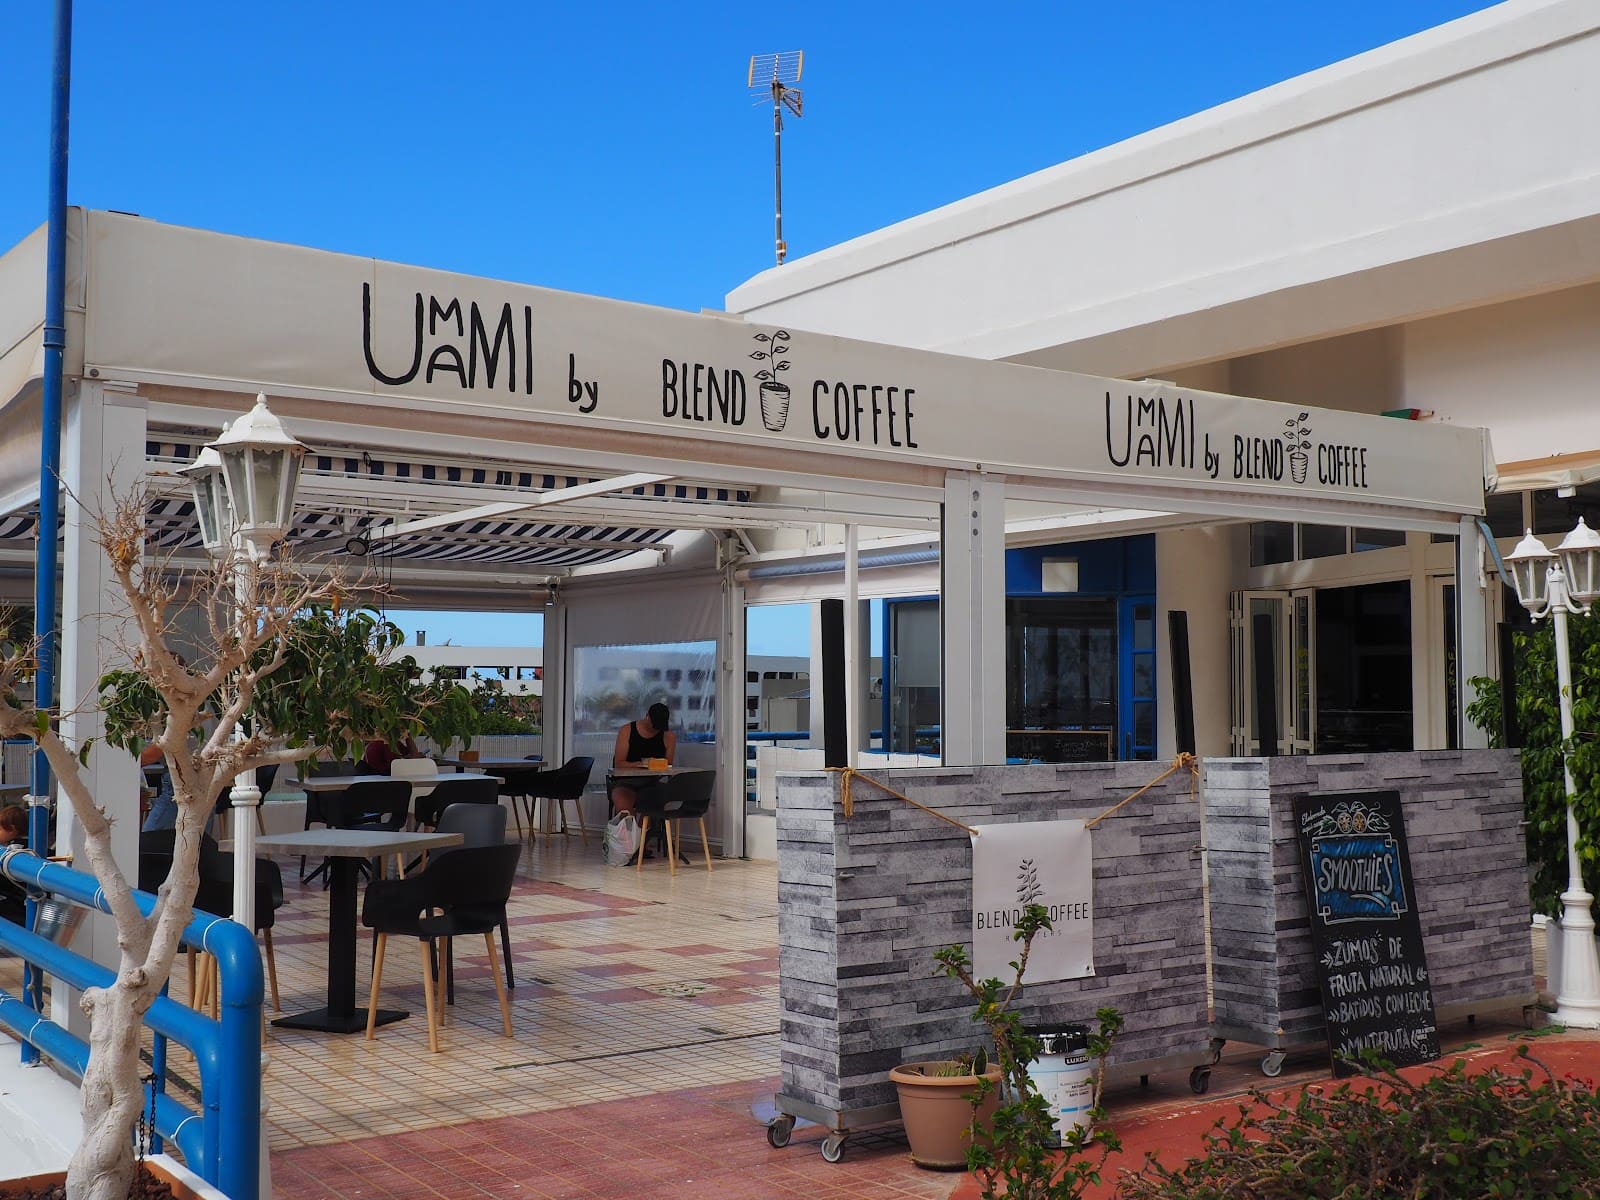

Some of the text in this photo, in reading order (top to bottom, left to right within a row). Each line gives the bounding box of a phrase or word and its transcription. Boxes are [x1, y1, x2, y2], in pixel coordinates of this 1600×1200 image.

[568, 353, 599, 414] by
[662, 358, 747, 426] BLEND
[812, 379, 918, 449] COFFEE
[1204, 432, 1220, 480] by
[1233, 434, 1284, 482] BLEND
[1317, 443, 1369, 489] COFFEE
[977, 902, 1089, 930] BLEND OFFEE
[1332, 936, 1404, 967] ZUMOS DE
[1328, 963, 1415, 998] FRUTA NATURAL
[1386, 993, 1404, 1015] CON
[1405, 990, 1432, 1014] LECHE
